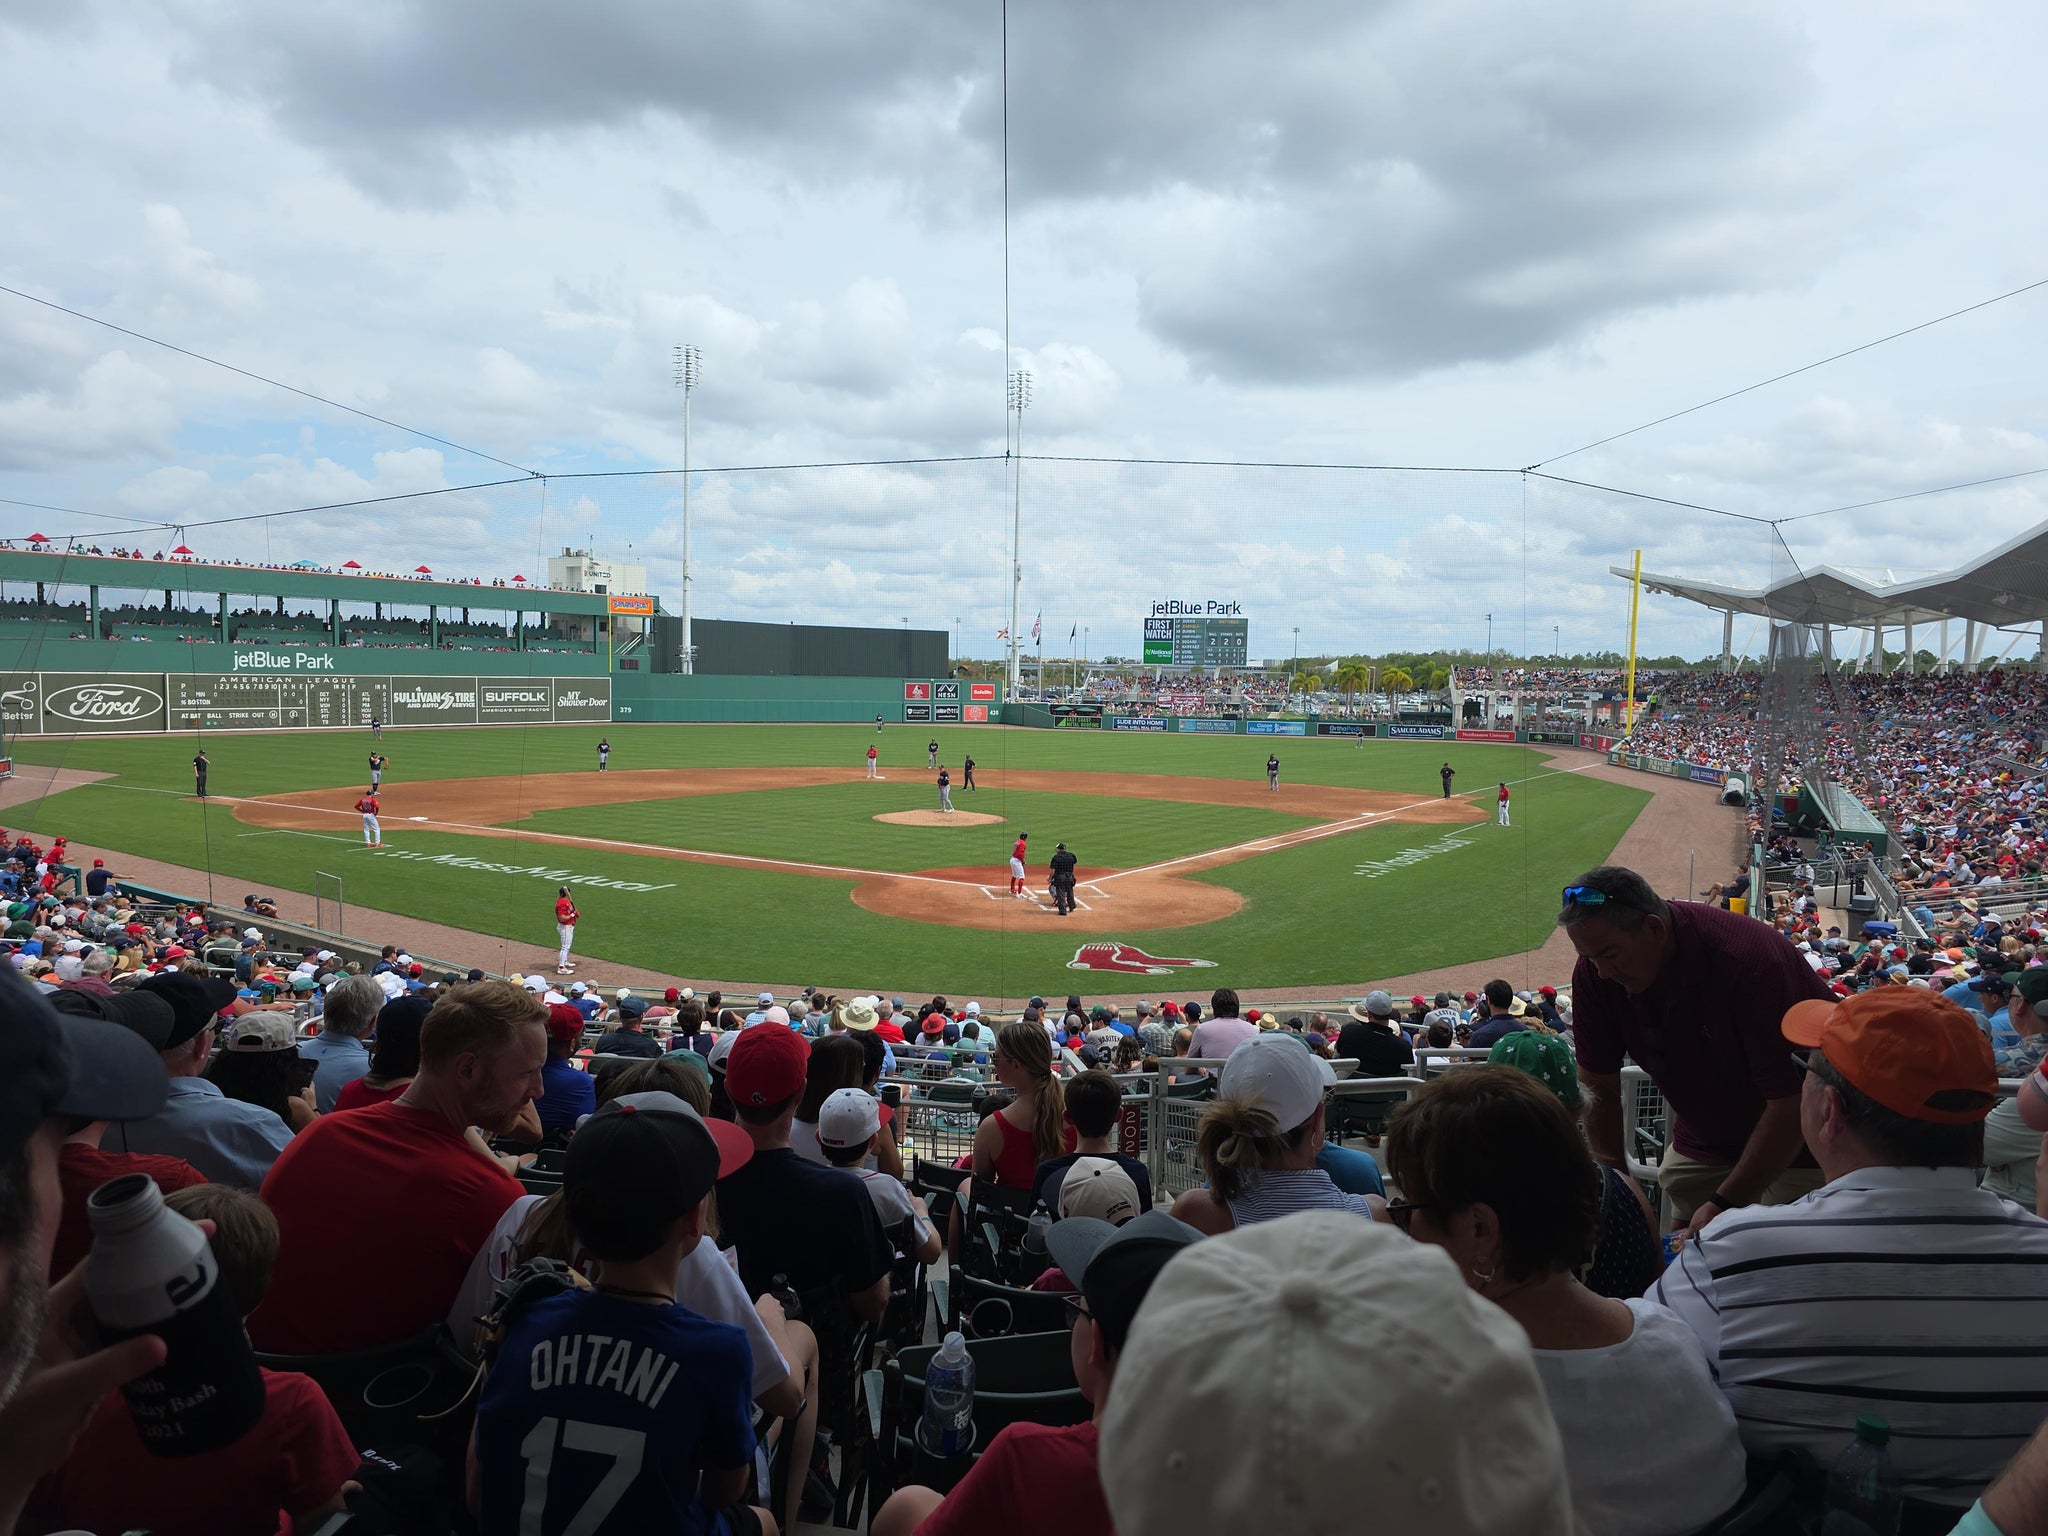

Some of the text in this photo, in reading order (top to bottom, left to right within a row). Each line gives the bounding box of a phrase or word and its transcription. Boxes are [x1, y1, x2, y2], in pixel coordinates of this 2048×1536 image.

[1152, 600, 1242, 617] jetBlue Park
[1148, 620, 1171, 630] FIRST
[1145, 630, 1172, 639] WATCH
[233, 650, 334, 671] jetBlue Park
[394, 692, 475, 703] SULLIVAN TIRE
[486, 692, 545, 702] SUFFOLK
[567, 691, 581, 699] MY
[69, 688, 142, 716] Ford
[557, 696, 607, 707] Shower Door
[3, 712, 33, 720] Better
[1391, 727, 1441, 735] SAMUEL ADAMS
[418, 854, 677, 892] MassMutual
[1098, 1036, 1120, 1044] VARITE
[1125, 1112, 1136, 1152] 202
[530, 1334, 680, 1410] OHTANI
[170, 1383, 216, 1413] Bash
[519, 1416, 647, 1536] 17
